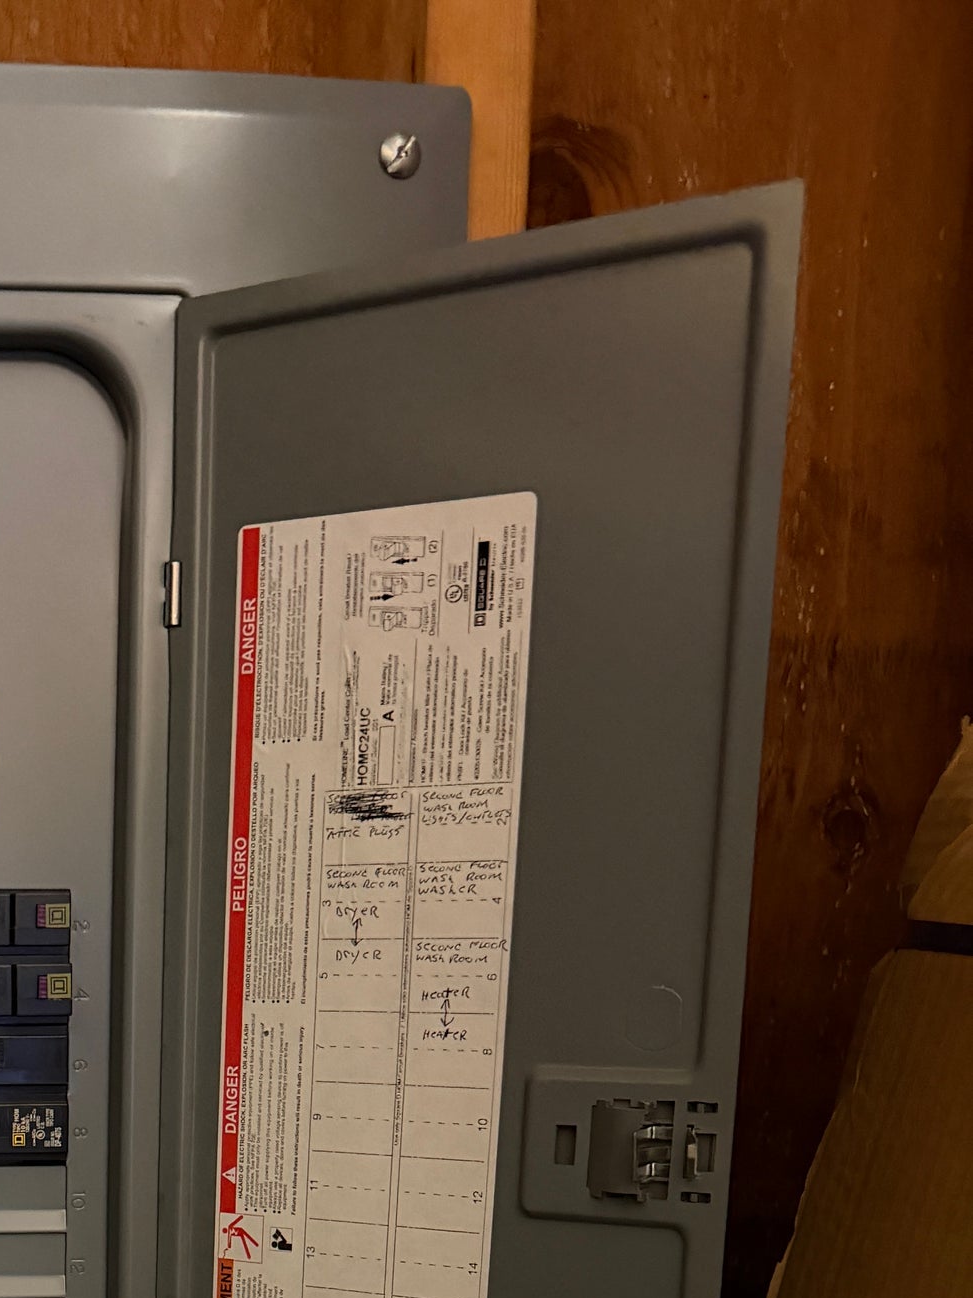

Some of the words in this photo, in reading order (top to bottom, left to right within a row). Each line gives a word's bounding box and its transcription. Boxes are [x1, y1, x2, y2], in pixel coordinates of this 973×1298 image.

[428, 540, 439, 554] (2)
[427, 573, 437, 587] (1)
[241, 598, 256, 675] DANGER
[383, 710, 395, 722] A
[357, 707, 371, 786] HOMC24UC
[232, 837, 247, 912] PELIGRO
[322, 899, 332, 907] 3
[492, 897, 502, 905] 4
[74, 919, 90, 934] 2
[449, 953, 488, 964] ROOM
[487, 973, 497, 981] 6
[73, 988, 90, 1001] 4
[482, 1048, 492, 1056] 8
[73, 1060, 88, 1072] 6
[224, 1065, 239, 1134] DANGER
[478, 1118, 488, 1131] 10
[73, 1127, 88, 1138] 8
[310, 1180, 318, 1191] 11
[71, 1192, 87, 1209] 10
[473, 1191, 483, 1204] 12
[306, 1246, 315, 1259] 13
[71, 1259, 86, 1274] 12
[468, 1263, 478, 1275] 14
